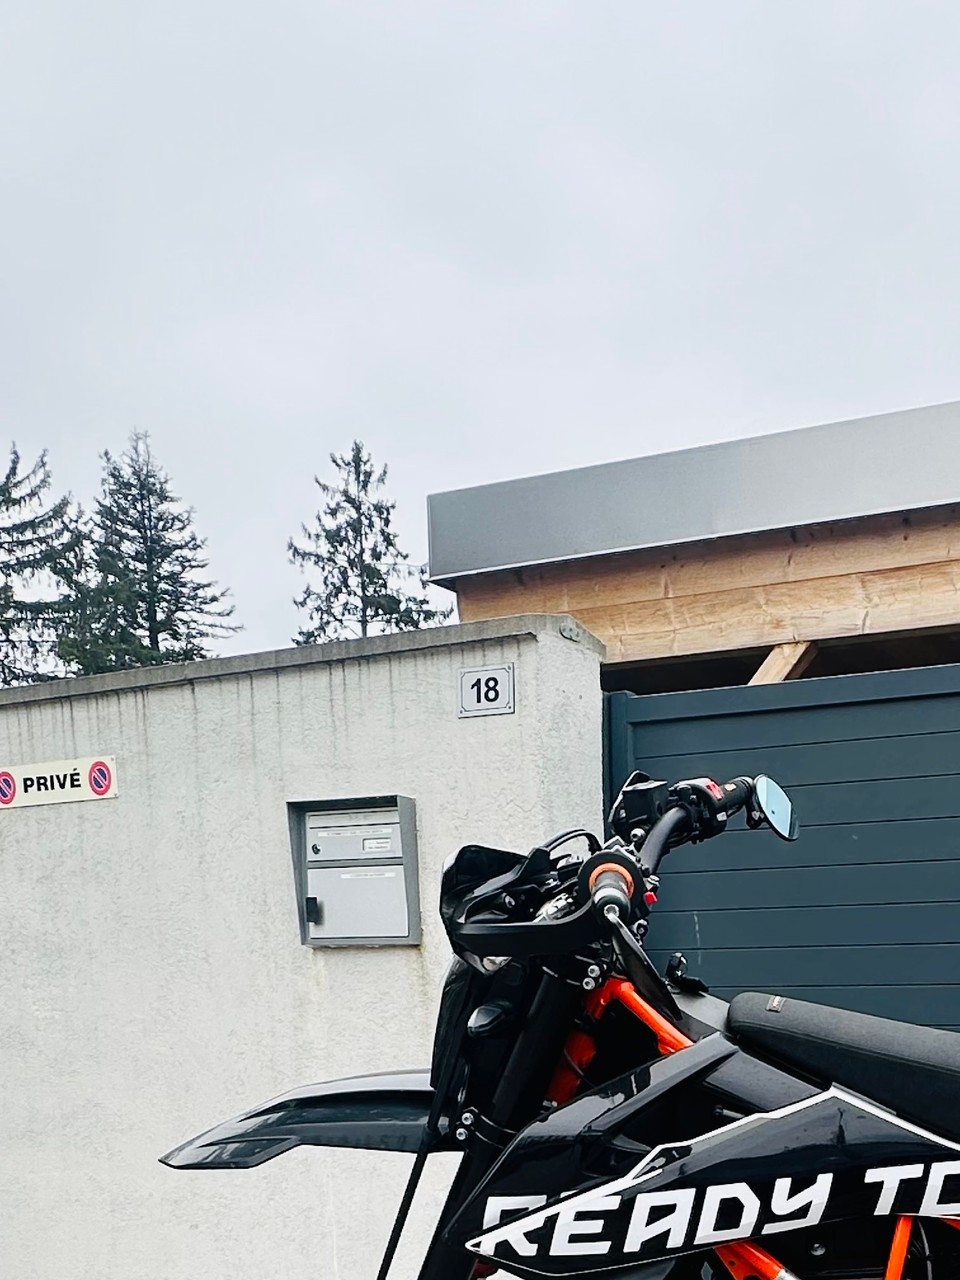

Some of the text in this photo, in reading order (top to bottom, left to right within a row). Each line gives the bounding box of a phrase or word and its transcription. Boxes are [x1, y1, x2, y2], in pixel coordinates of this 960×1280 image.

[470, 676, 500, 704] 18
[23, 768, 82, 793] PRIVÉ
[482, 1172, 834, 1257] READY
